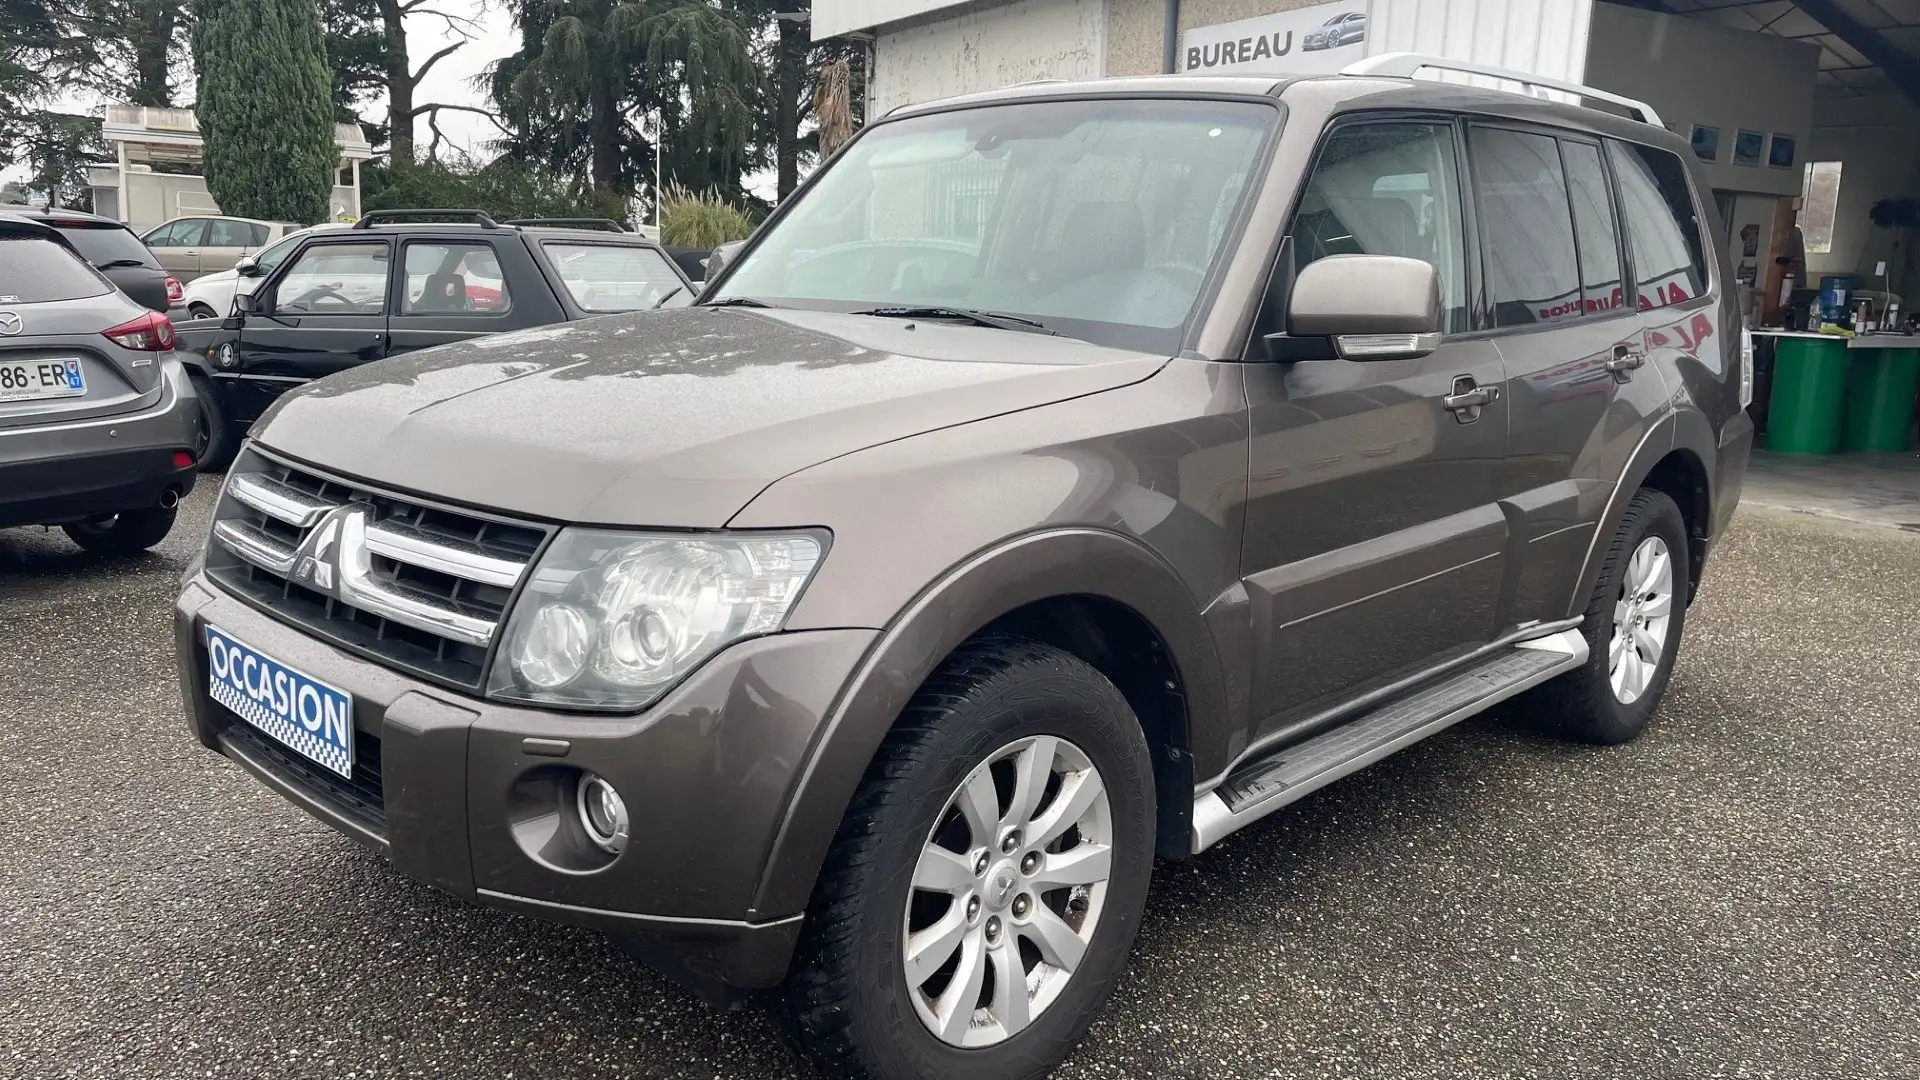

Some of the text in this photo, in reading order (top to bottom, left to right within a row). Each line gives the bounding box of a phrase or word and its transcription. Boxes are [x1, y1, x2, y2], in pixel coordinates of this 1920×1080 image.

[1186, 30, 1293, 71] BUREAU
[69, 376, 82, 388] 47
[210, 636, 346, 748] OCCASION
